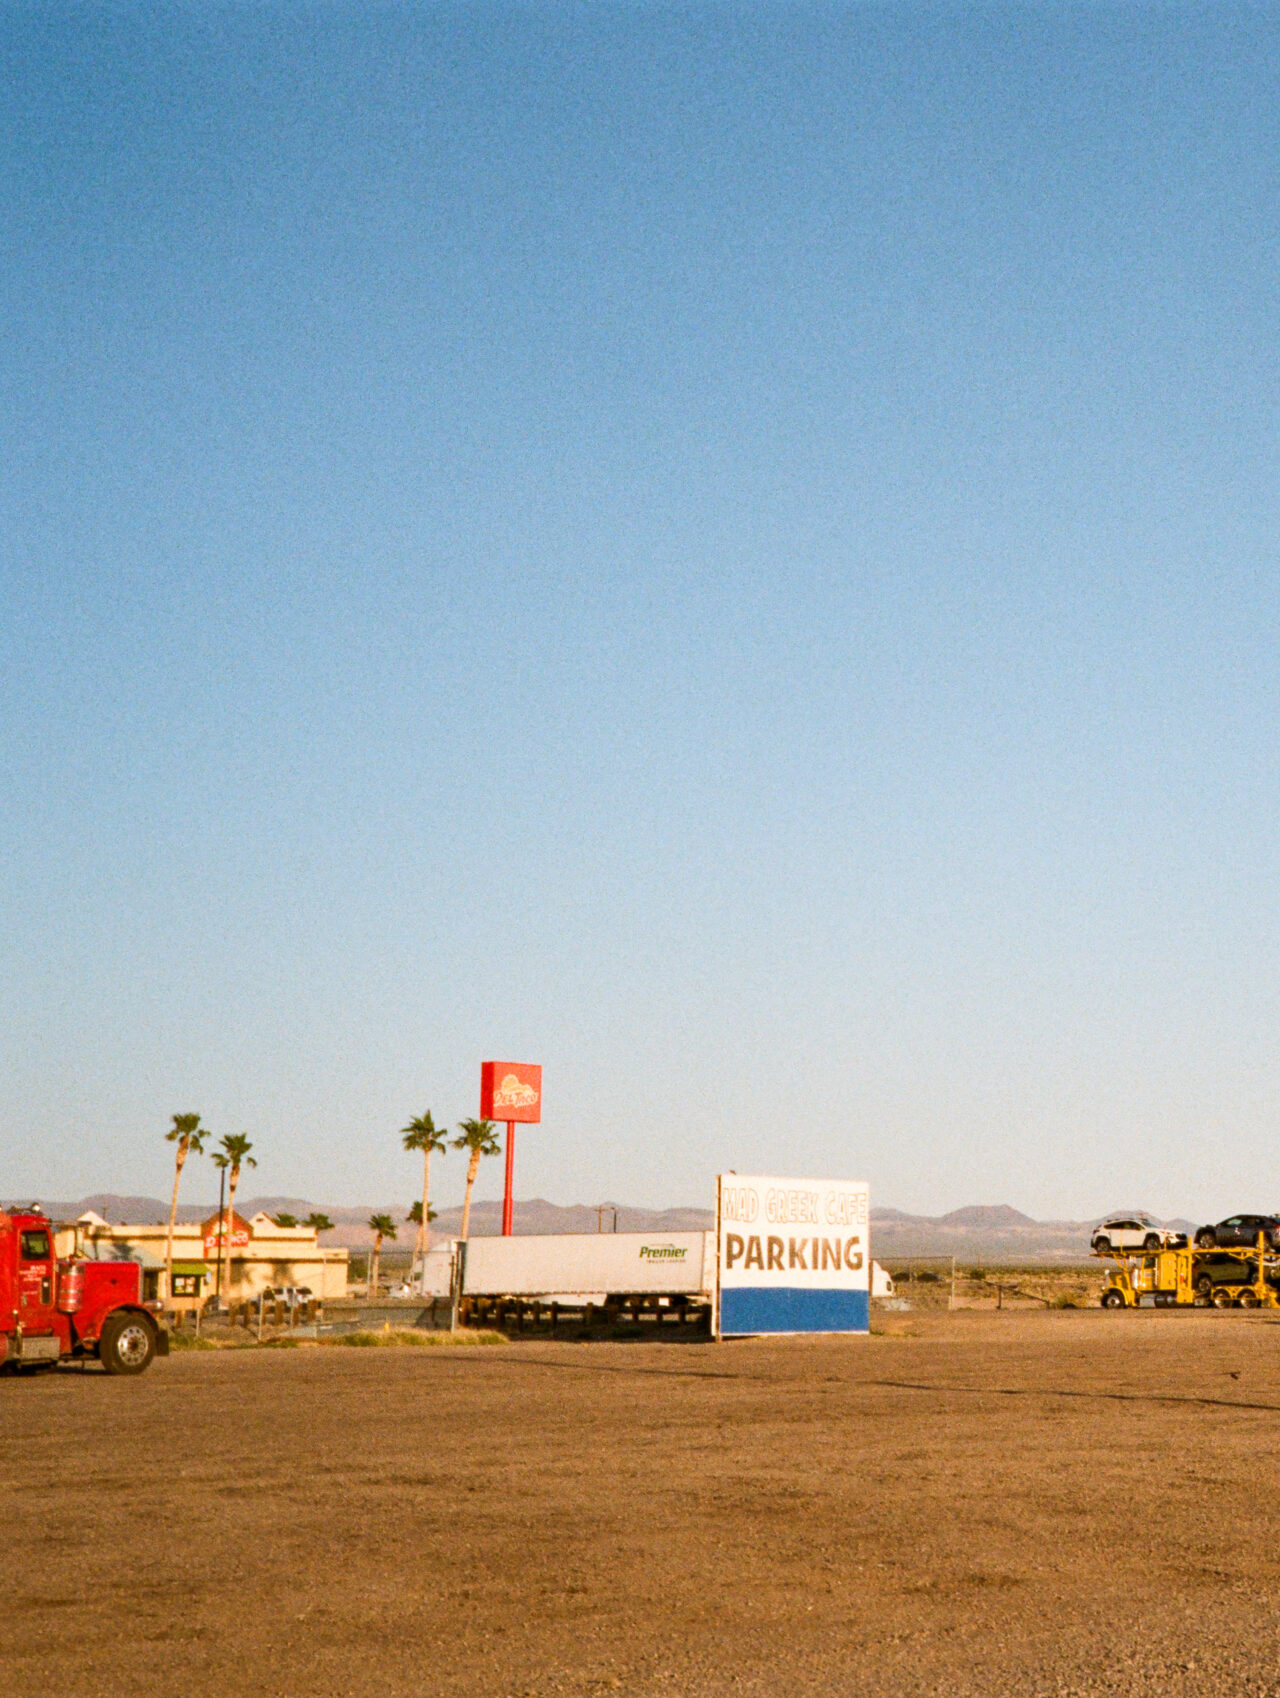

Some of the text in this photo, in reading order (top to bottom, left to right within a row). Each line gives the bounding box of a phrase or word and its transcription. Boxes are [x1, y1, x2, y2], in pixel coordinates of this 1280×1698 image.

[722, 1187, 867, 1226] MAD GREEK CAFE
[639, 1246, 687, 1258] Premier
[726, 1233, 863, 1271] PARKING
